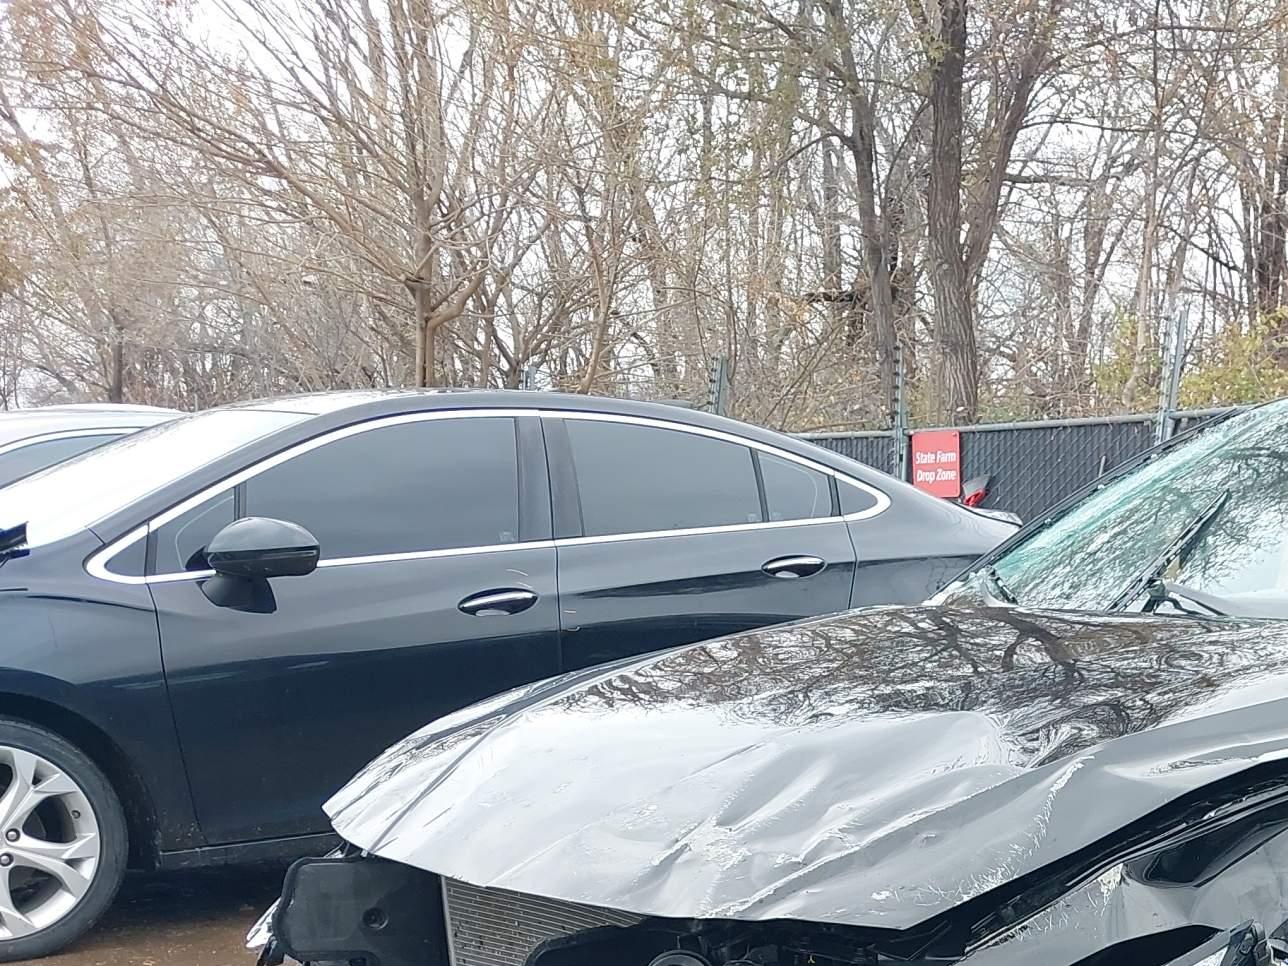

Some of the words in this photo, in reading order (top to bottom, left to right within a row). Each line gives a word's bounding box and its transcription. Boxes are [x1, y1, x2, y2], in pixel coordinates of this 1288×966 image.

[915, 451, 935, 464] State
[936, 450, 956, 463] Farm
[916, 470, 935, 483] Drop
[936, 469, 957, 481] Zone
